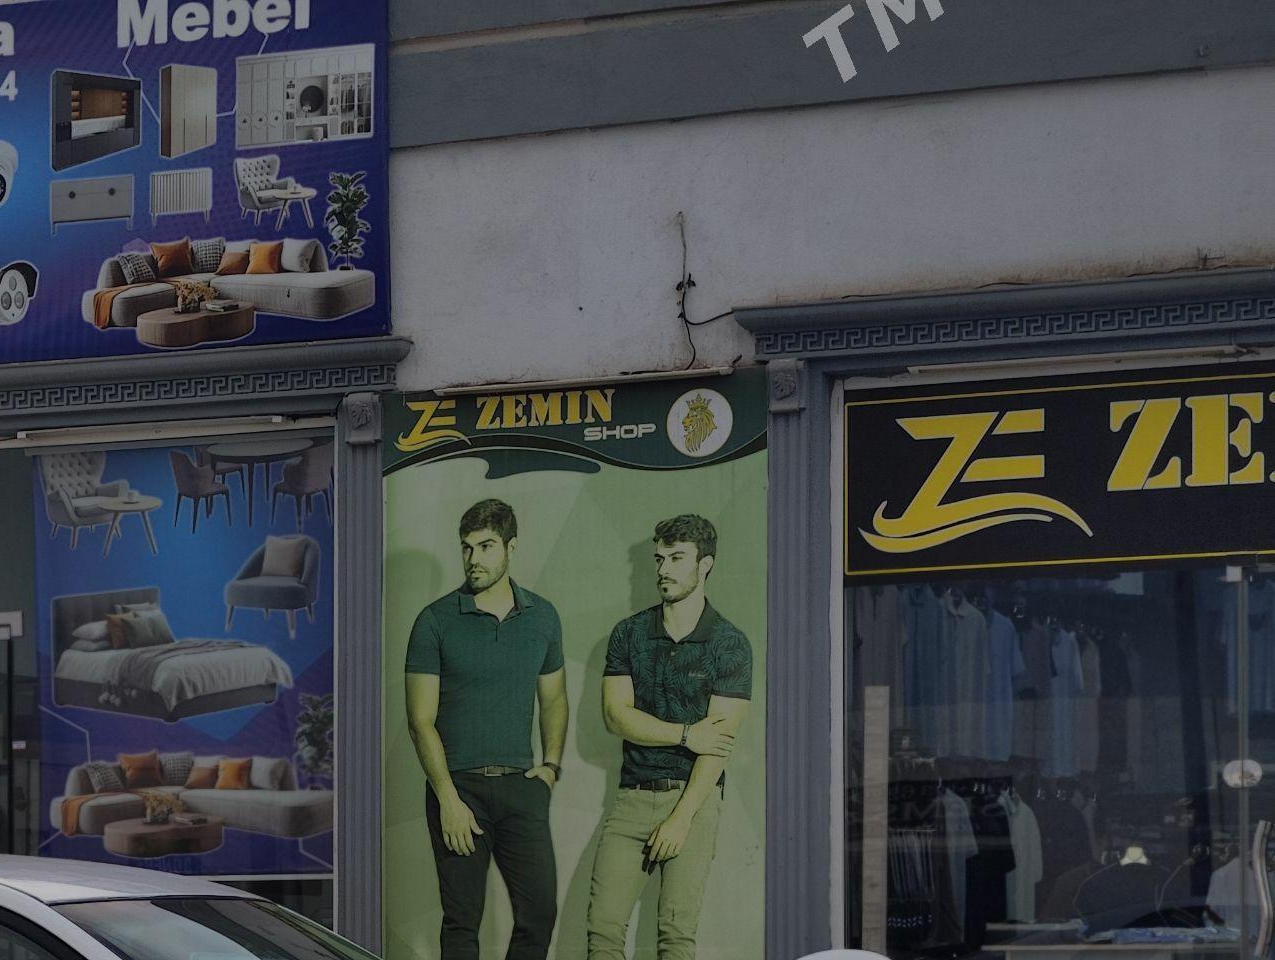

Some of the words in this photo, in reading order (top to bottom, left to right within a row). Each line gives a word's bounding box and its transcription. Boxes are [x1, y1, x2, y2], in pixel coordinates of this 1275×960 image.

[117, 0, 310, 48] Mebel
[475, 388, 616, 430] ZEMIN
[584, 423, 657, 442] SHOP
[1106, 391, 1275, 491] ZE
